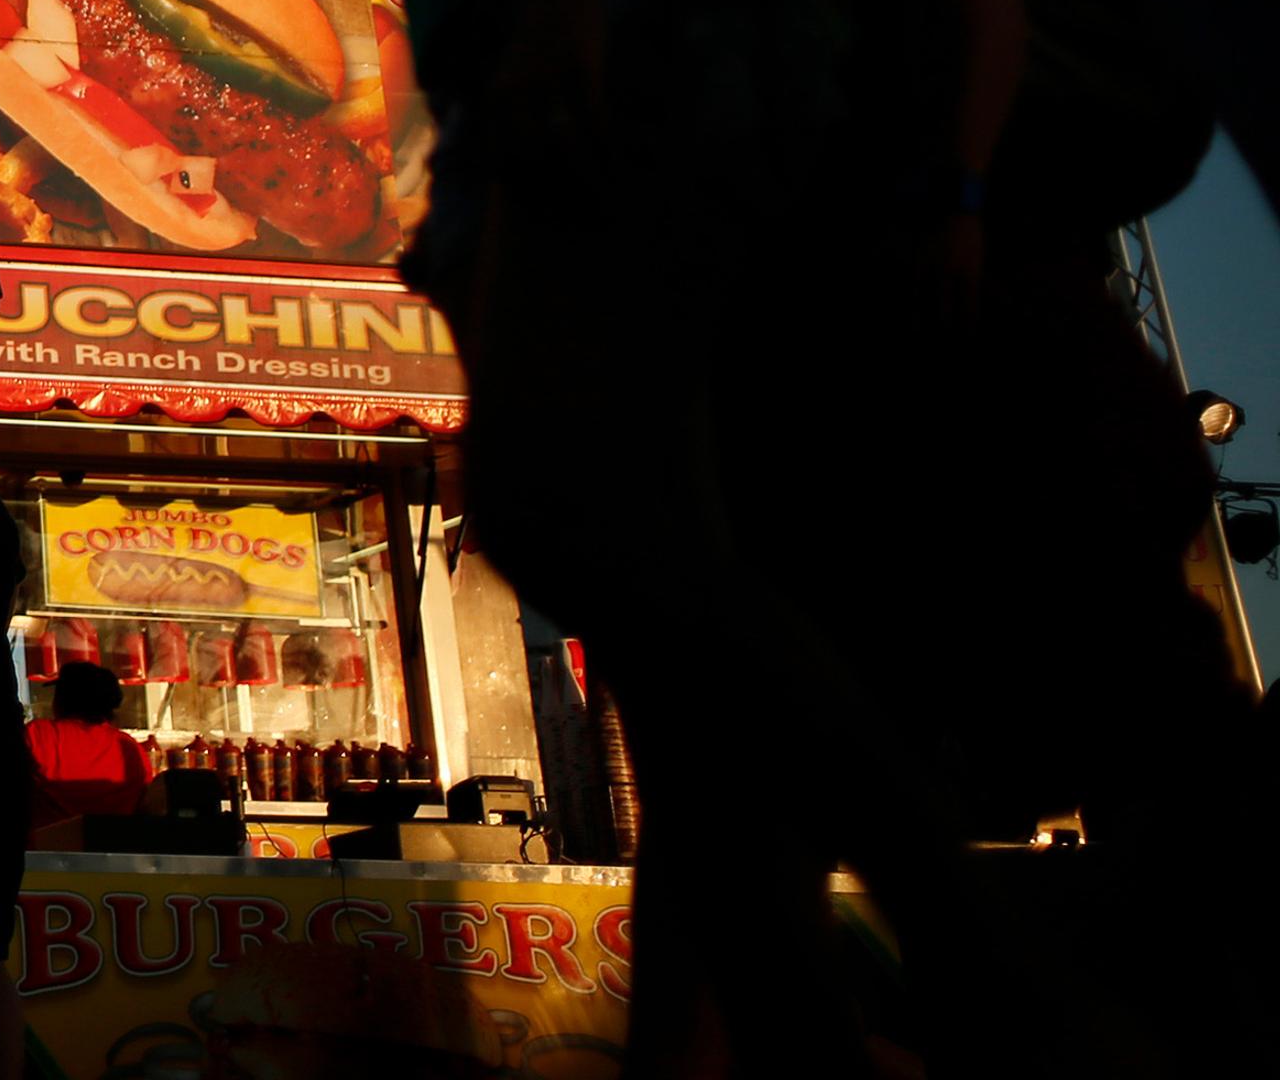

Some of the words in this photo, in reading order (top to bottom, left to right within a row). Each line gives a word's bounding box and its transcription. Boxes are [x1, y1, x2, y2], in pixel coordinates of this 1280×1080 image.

[75, 344, 186, 372] Ranch
[215, 350, 392, 386] Dressing
[122, 508, 233, 527] JUMBO
[59, 526, 175, 555] CORN
[190, 528, 307, 568] DOGS
